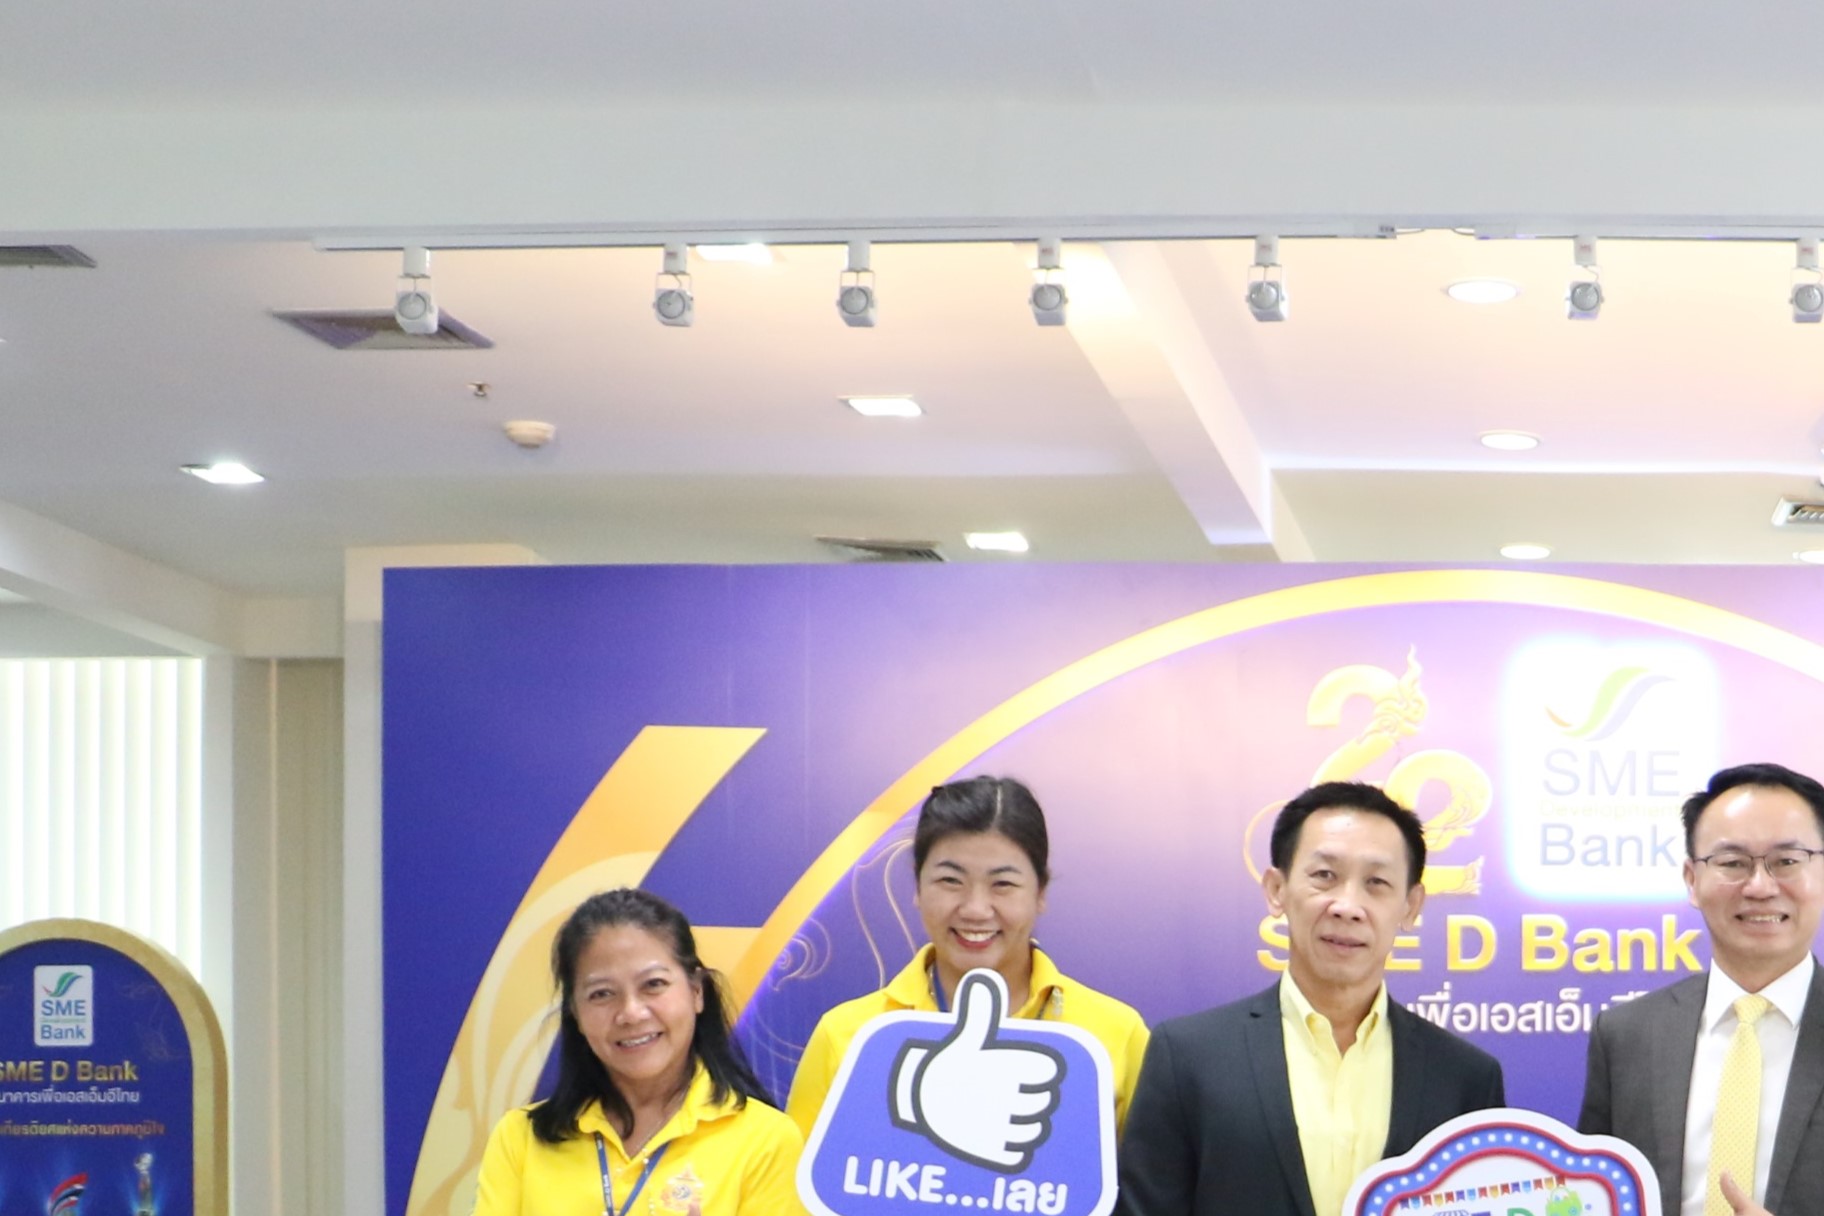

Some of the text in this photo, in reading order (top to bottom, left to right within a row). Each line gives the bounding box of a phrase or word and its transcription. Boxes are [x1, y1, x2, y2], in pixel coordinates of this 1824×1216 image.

[1542, 748, 1681, 796] SME
[1540, 823, 1679, 868] Bank
[1447, 914, 1497, 972] D
[1522, 914, 1703, 974] Bank
[41, 1000, 87, 1016] SME
[40, 1024, 86, 1040] Bank
[51, 1060, 70, 1082] D
[76, 1060, 139, 1082] Bank
